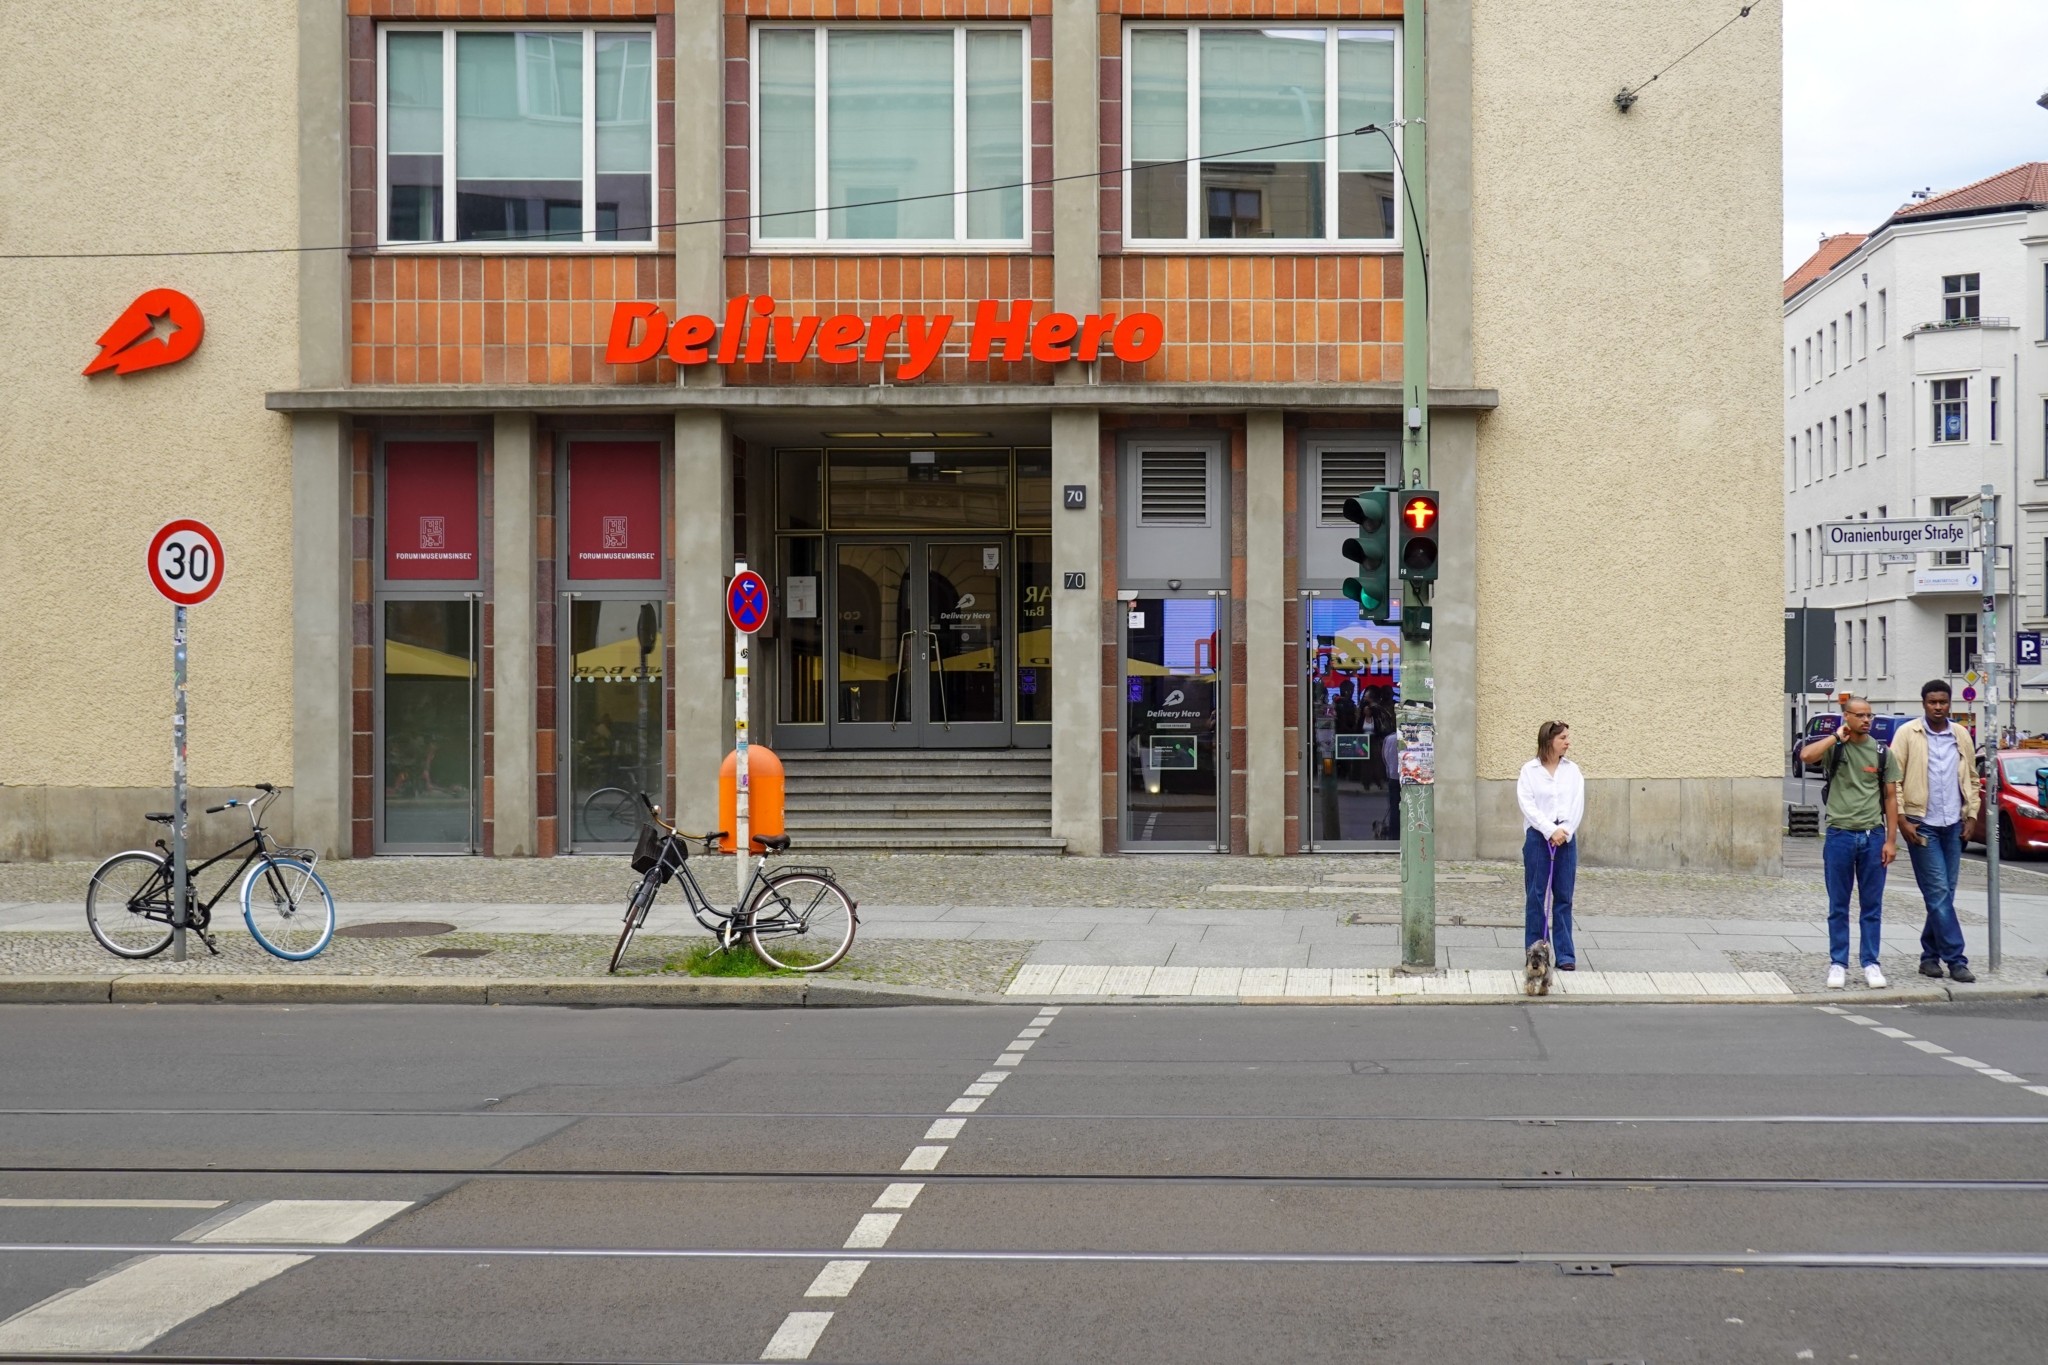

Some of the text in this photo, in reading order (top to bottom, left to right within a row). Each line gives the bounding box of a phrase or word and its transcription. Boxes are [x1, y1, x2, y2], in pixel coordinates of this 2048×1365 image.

[605, 294, 1165, 380] Delivery Hero
[1067, 491, 1083, 502] 70
[1831, 523, 1964, 544] Oranienburger Straße
[165, 542, 209, 582] 30
[1066, 573, 1084, 588] 70
[940, 612, 972, 620] Delivery
[2021, 640, 2035, 658] P
[1147, 709, 1201, 719] Delivery Hero
